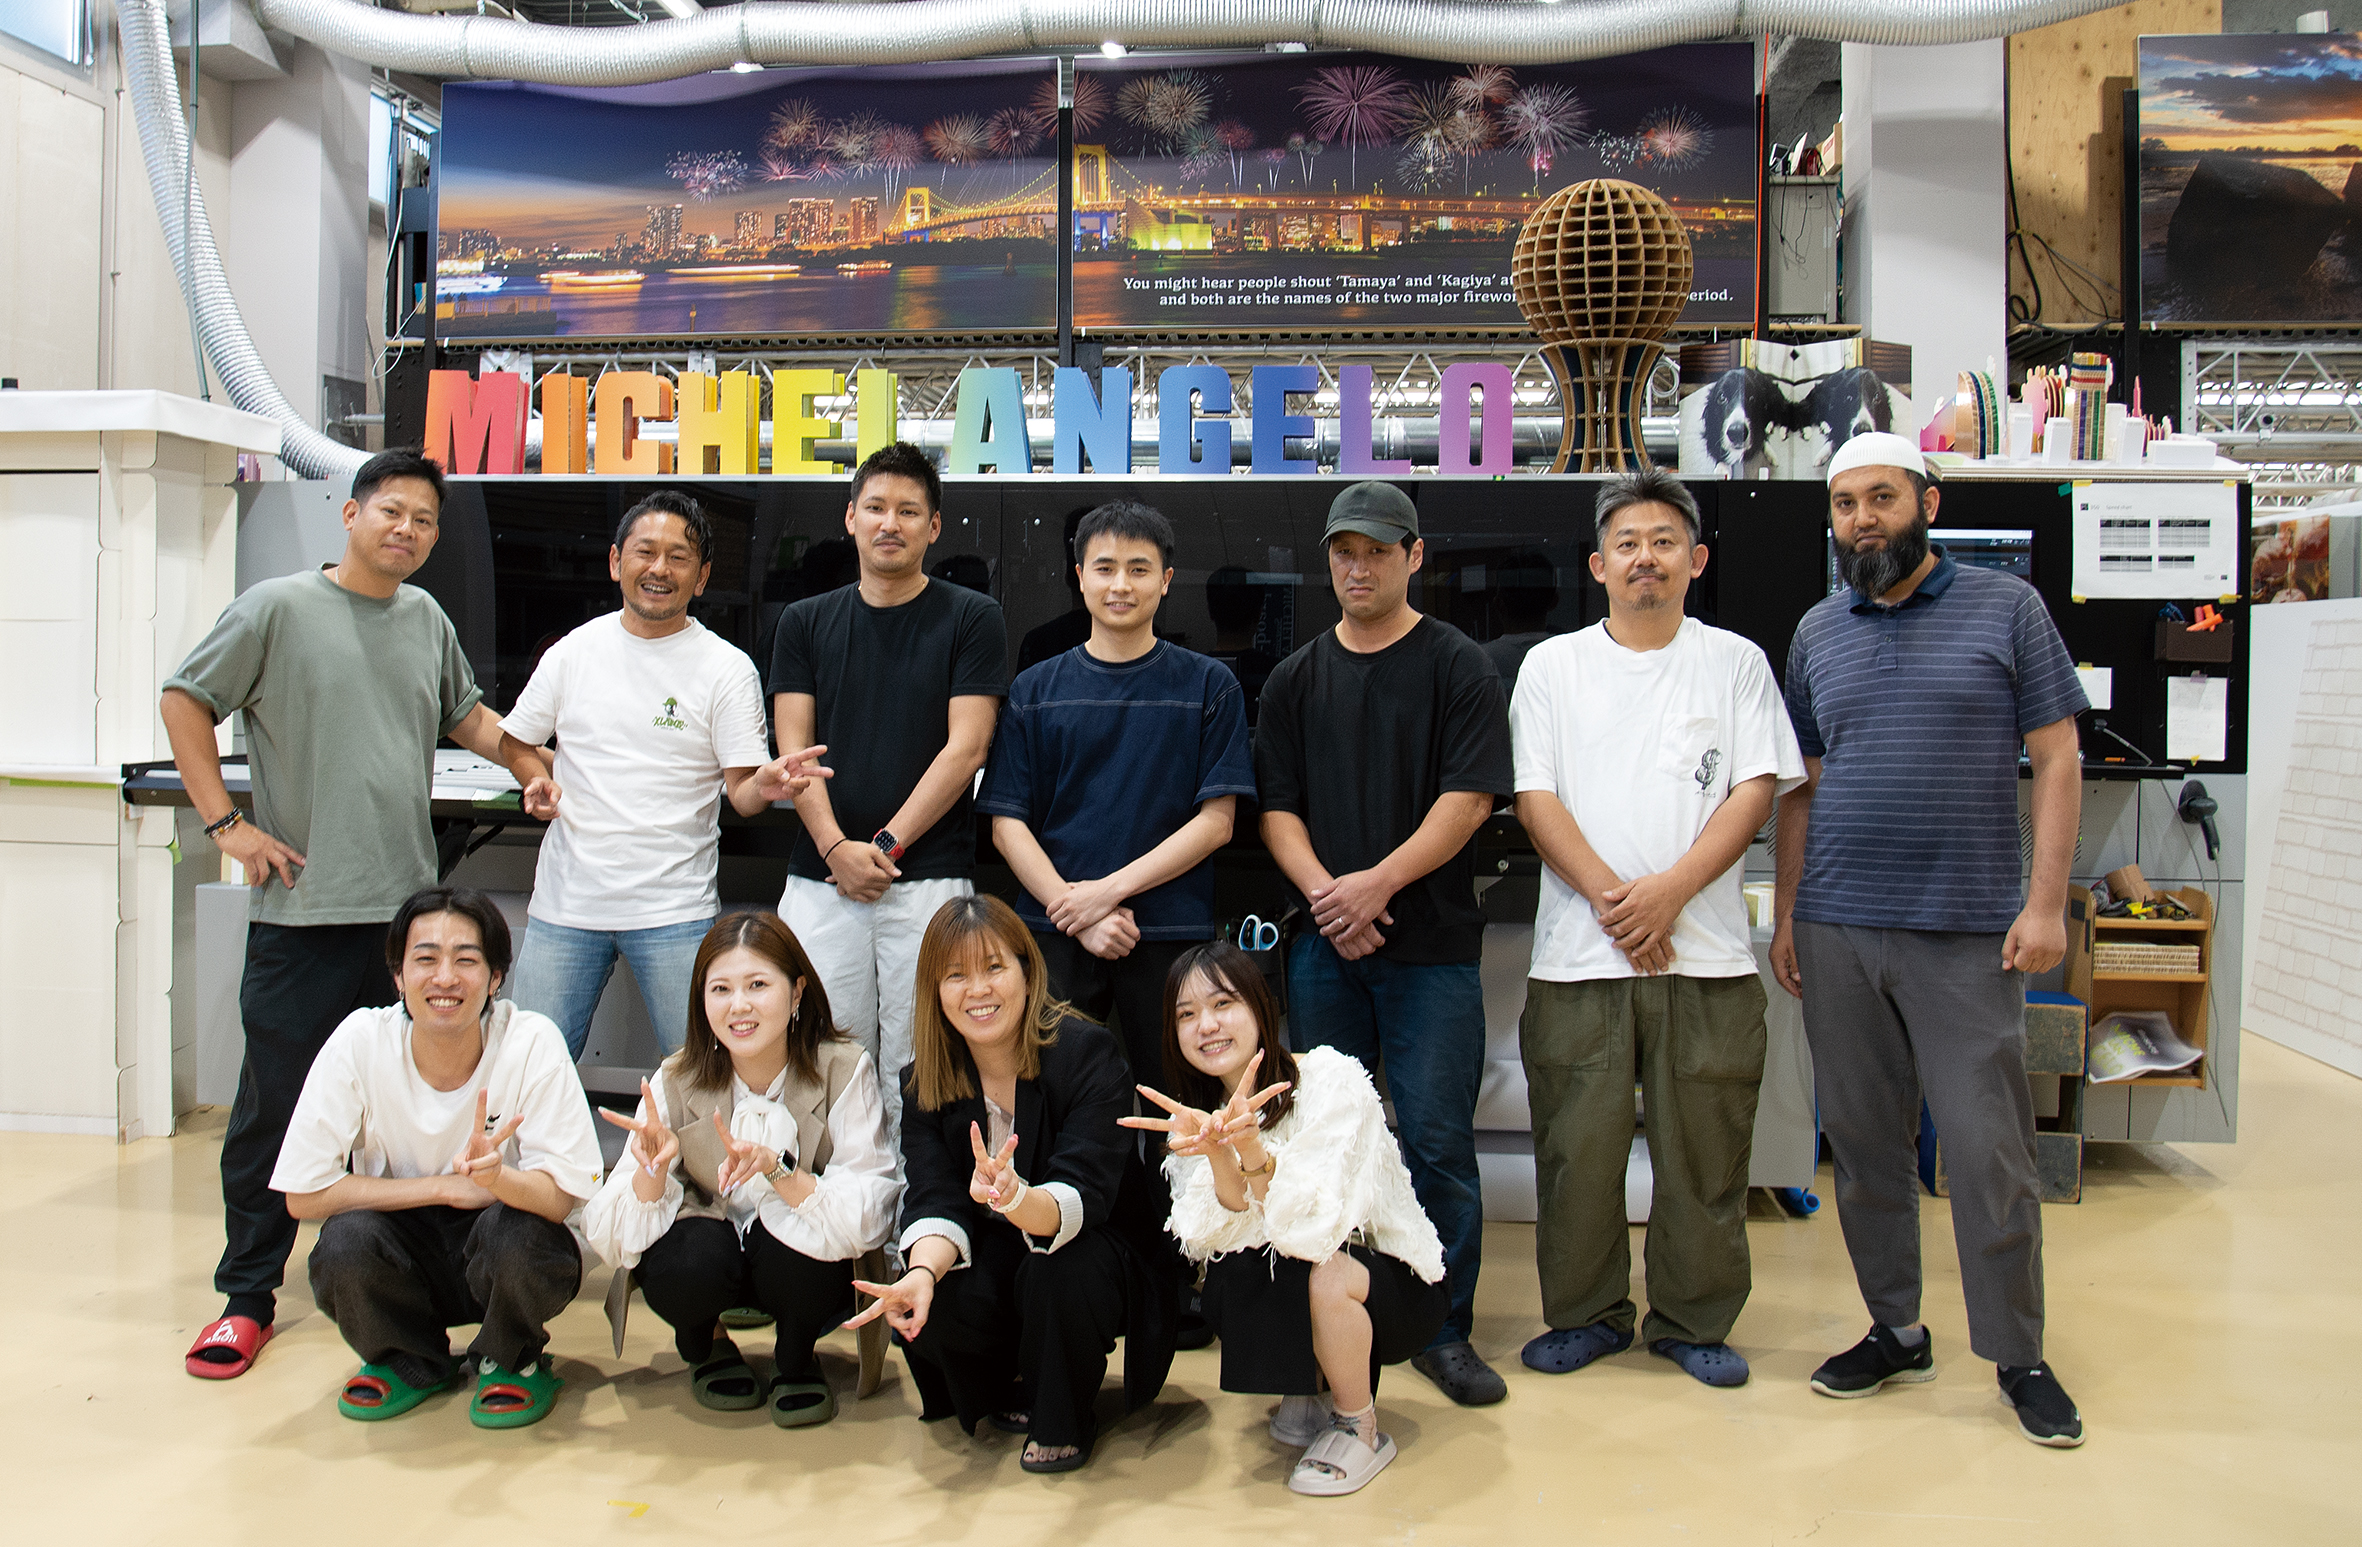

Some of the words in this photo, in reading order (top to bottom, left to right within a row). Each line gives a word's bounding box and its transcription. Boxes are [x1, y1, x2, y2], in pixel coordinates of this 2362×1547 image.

[1123, 277, 1150, 290] You
[1154, 276, 1197, 292] might
[1202, 276, 1235, 289] hear
[1238, 275, 1287, 292] people
[1291, 275, 1331, 289] shout
[1405, 274, 1432, 287] and
[1159, 292, 1187, 306] and
[1191, 292, 1224, 305] both
[1228, 294, 1252, 305] are
[1256, 292, 1280, 305] the
[1284, 293, 1332, 305] names
[1336, 291, 1353, 304] of
[1356, 291, 1380, 304] the
[1384, 292, 1412, 304] two
[1417, 290, 1460, 306] major
[1687, 288, 1734, 302] eriod.
[423, 363, 1514, 475] MICHELANGELO
